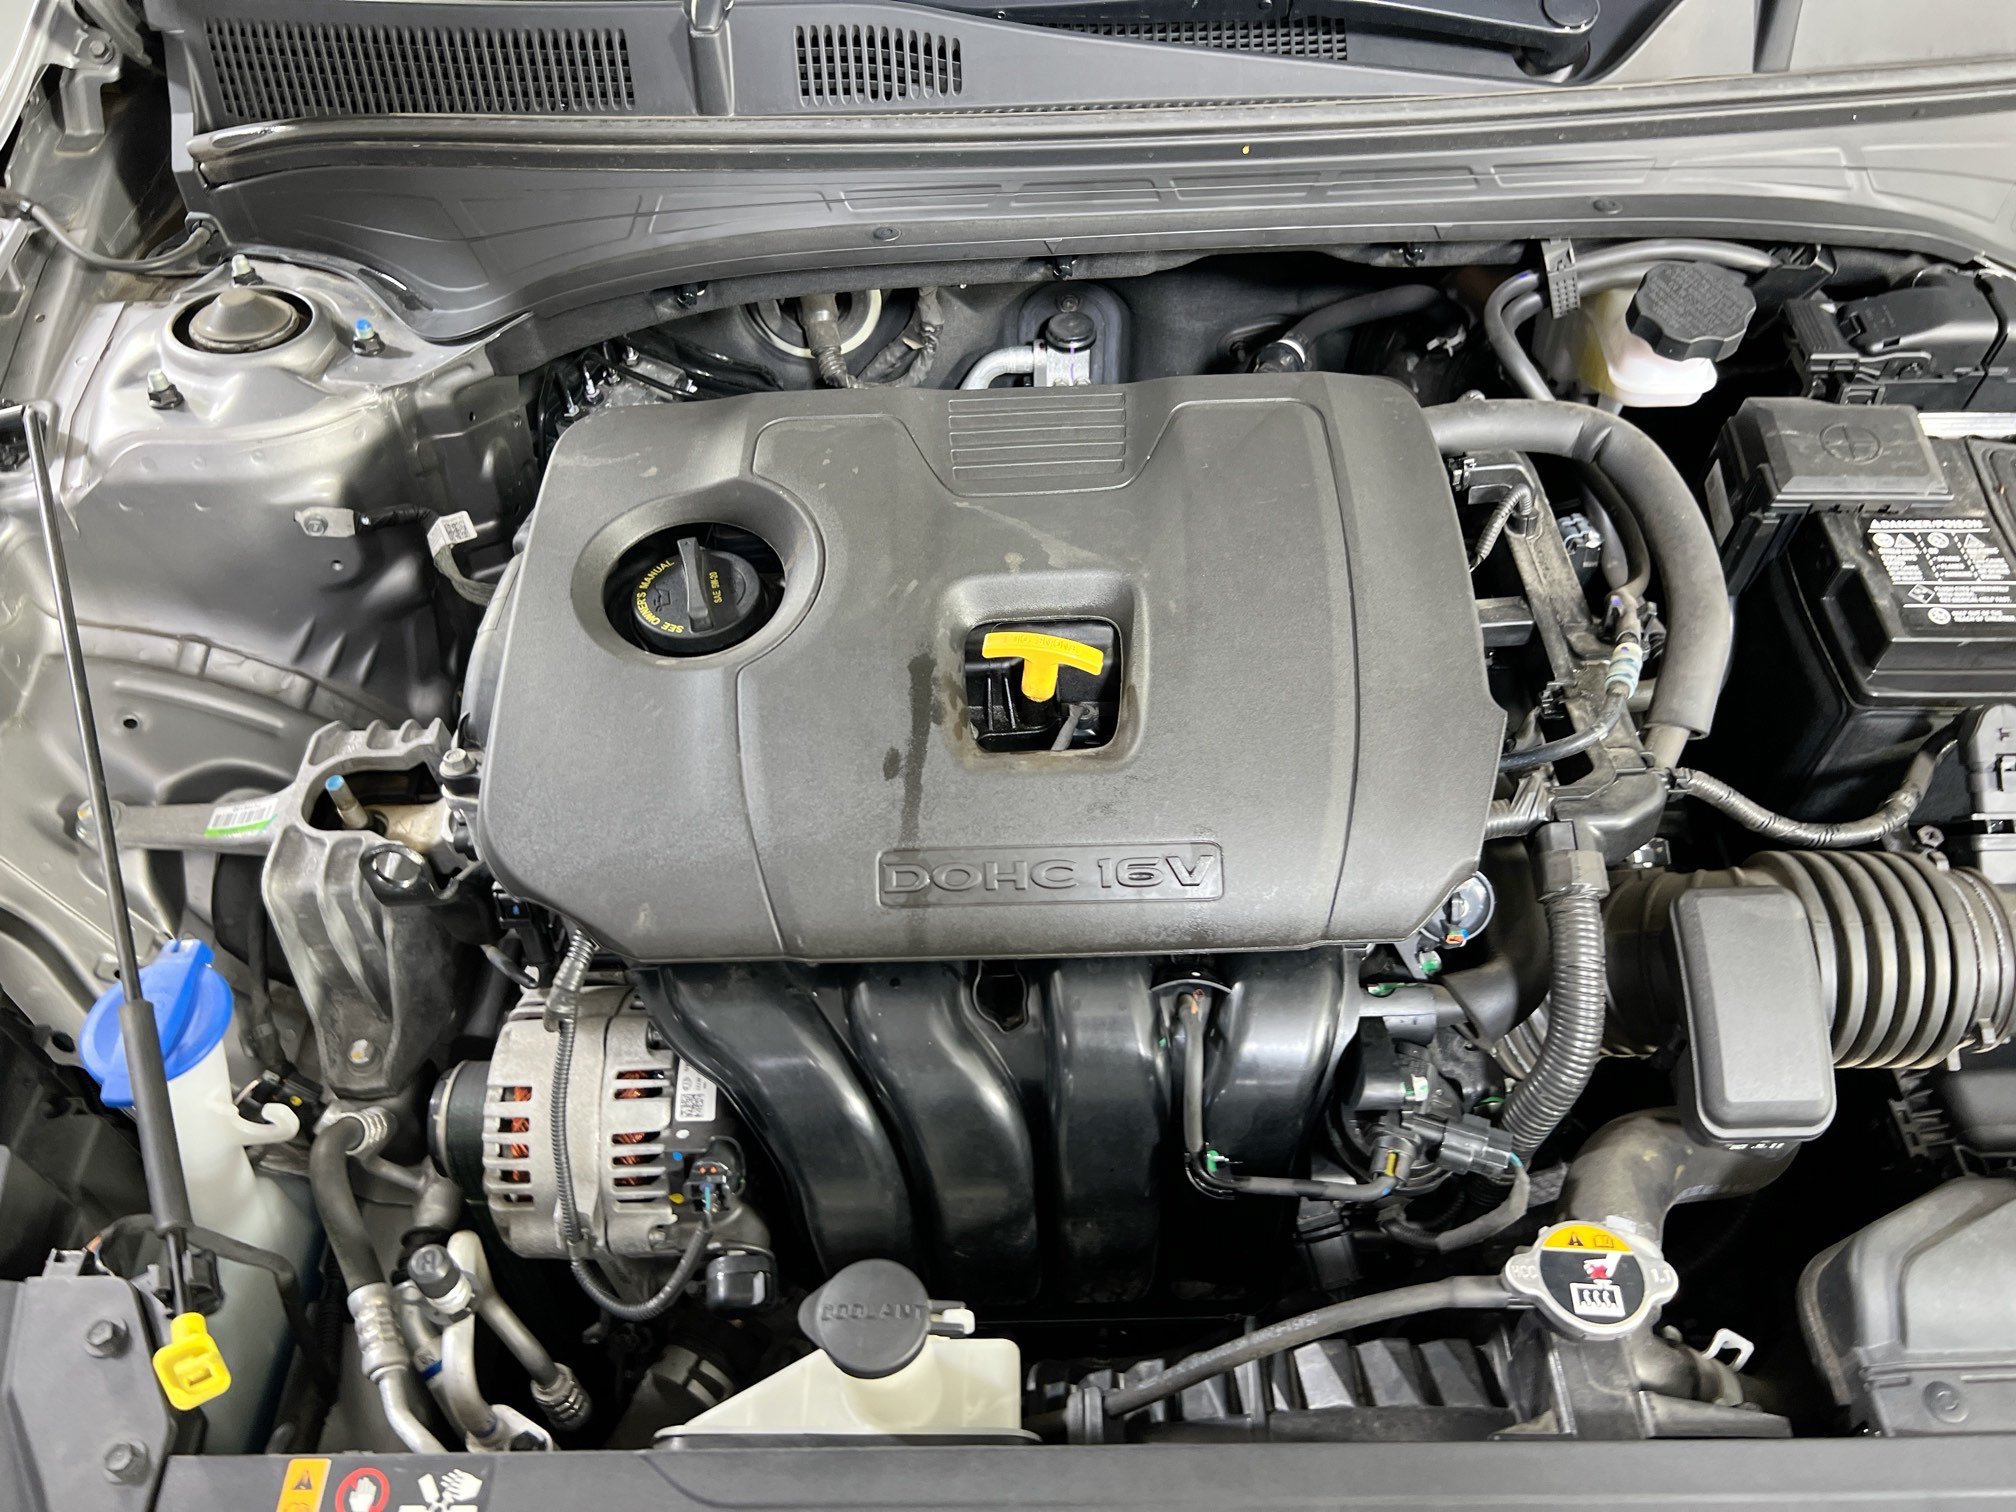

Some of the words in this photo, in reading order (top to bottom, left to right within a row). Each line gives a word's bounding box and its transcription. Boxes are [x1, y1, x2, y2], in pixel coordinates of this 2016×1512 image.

[1880, 519, 1984, 529] DANGER/POISON
[639, 560, 675, 590] MANUAL
[712, 589, 723, 605] SAE
[635, 592, 661, 626] OWNER'S
[661, 622, 684, 633] SEE
[882, 859, 1080, 893] DOHC
[1097, 854, 1215, 888] 16V
[821, 1302, 927, 1322] COOLANT
